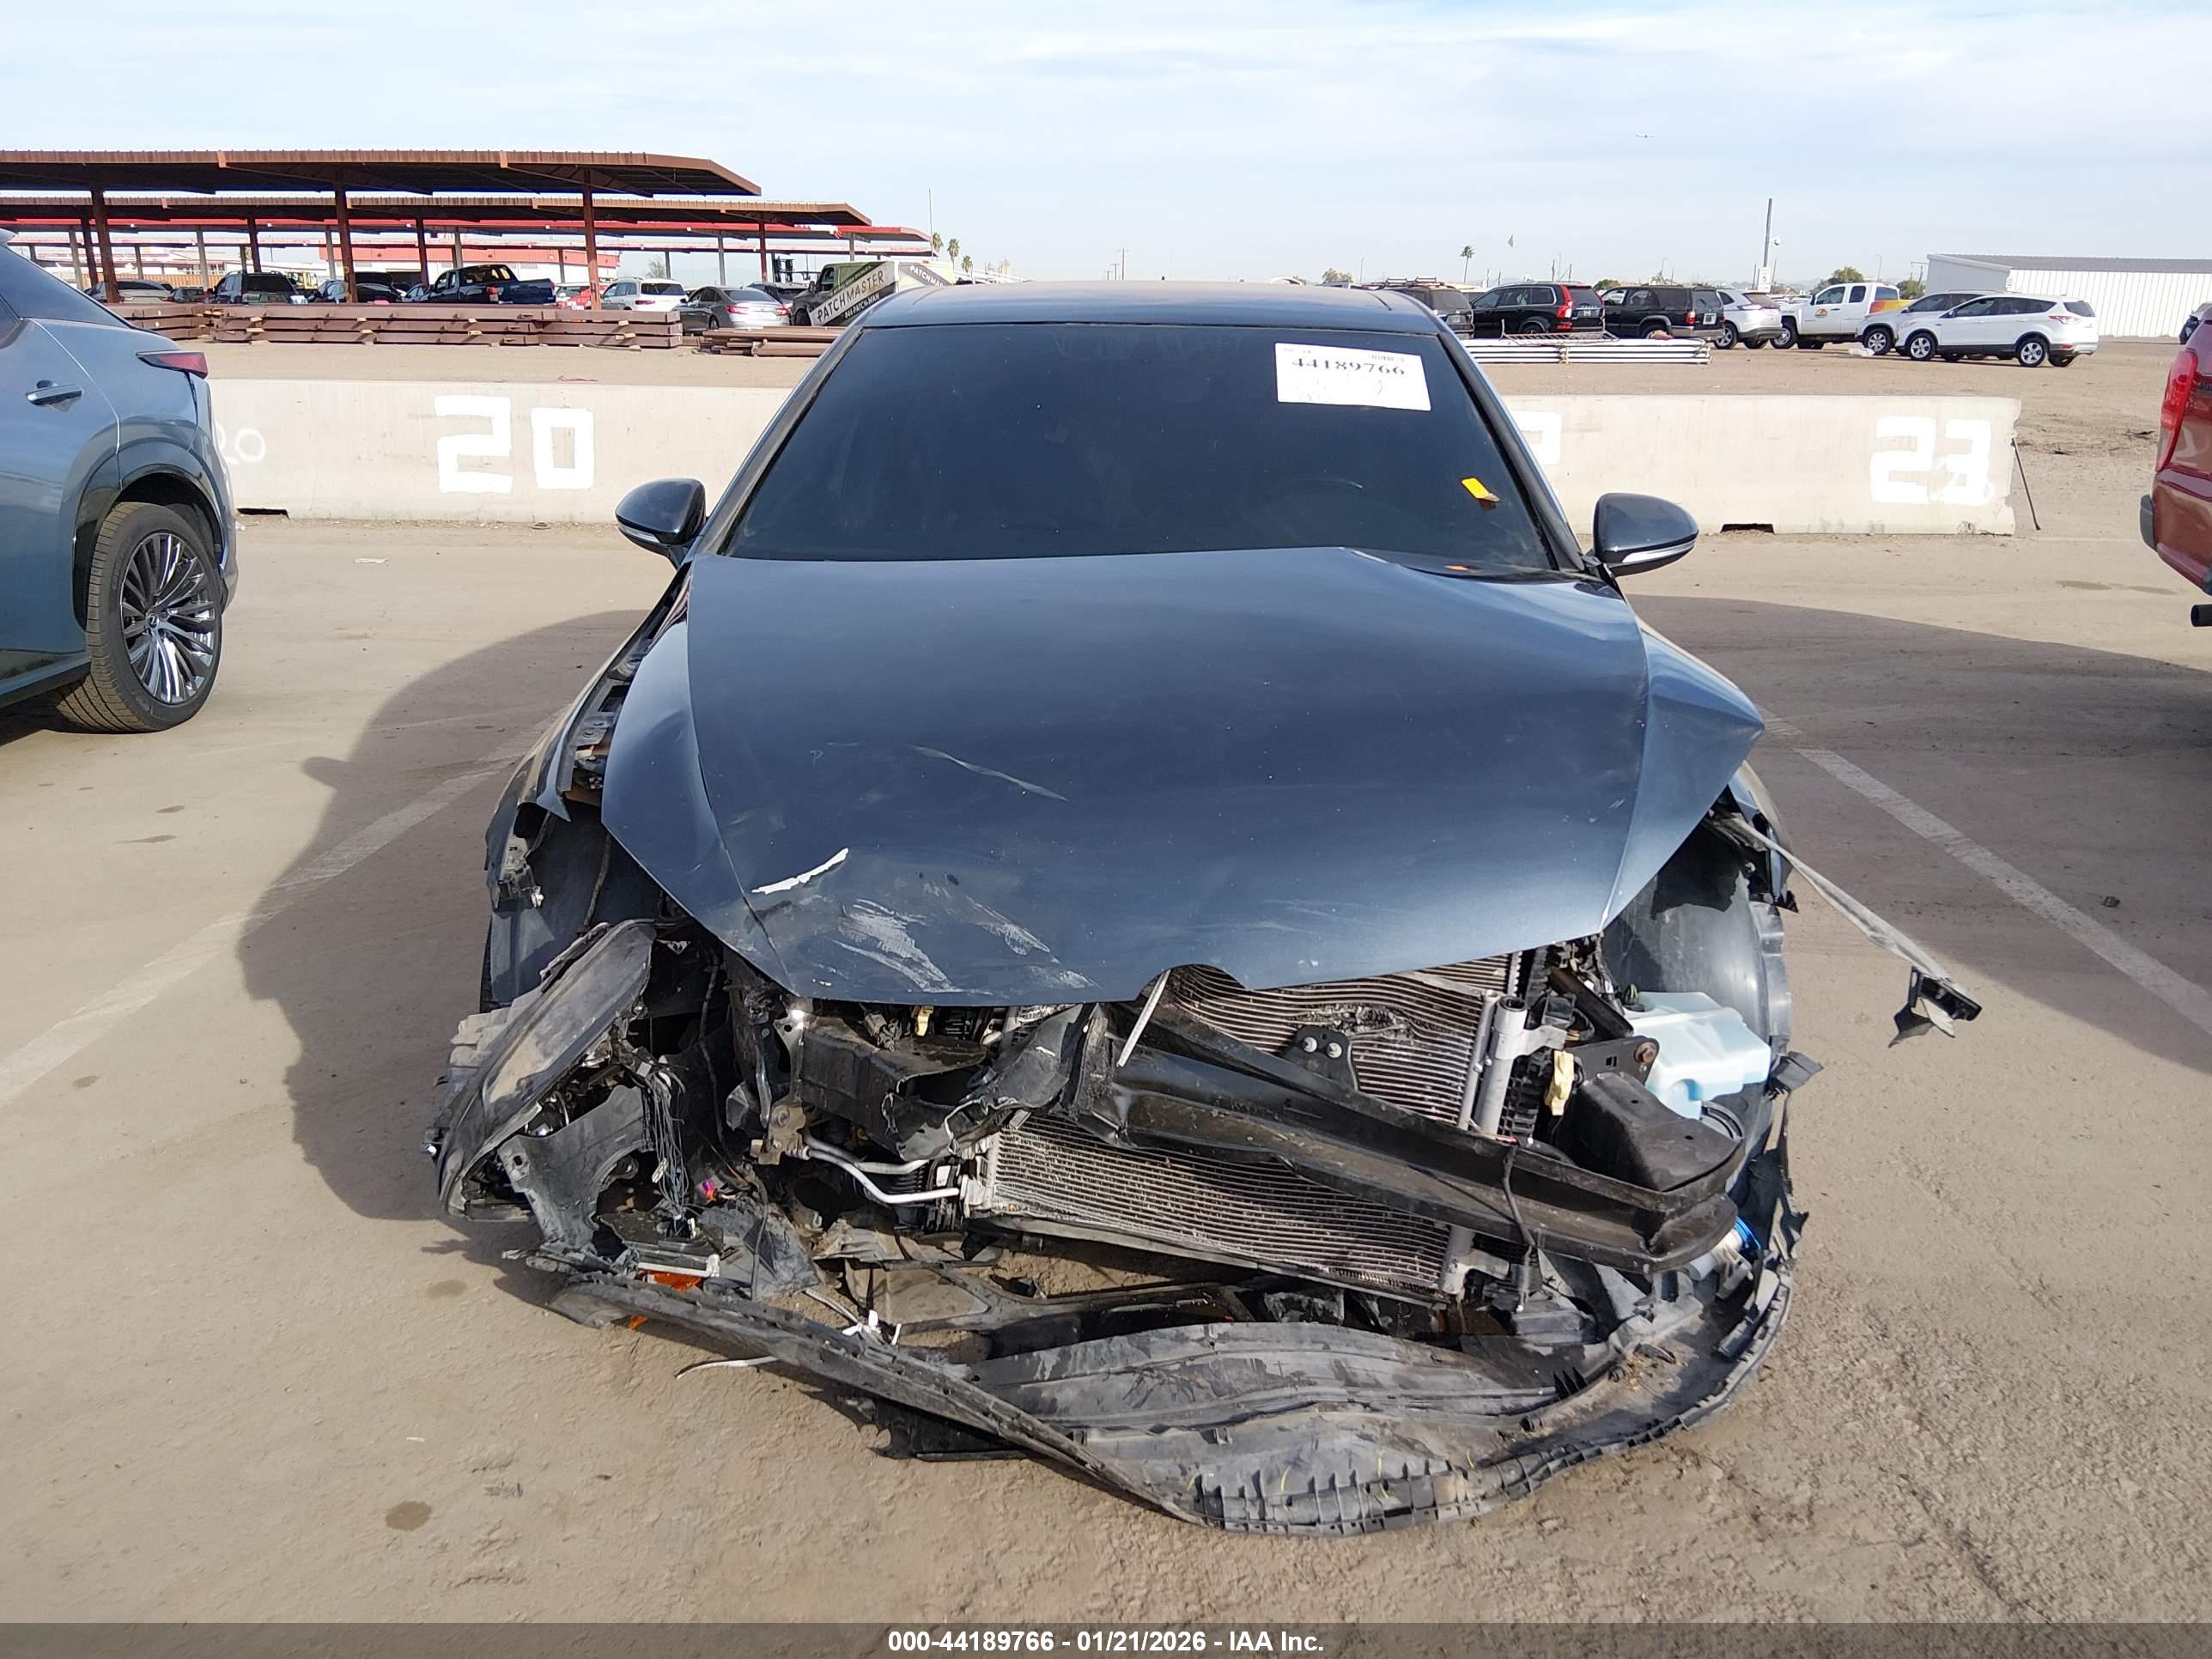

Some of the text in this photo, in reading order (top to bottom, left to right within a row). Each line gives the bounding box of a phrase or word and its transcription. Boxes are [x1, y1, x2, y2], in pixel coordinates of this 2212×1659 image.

[817, 270, 884, 321] PATCHMASTER
[1291, 358, 1405, 375] 44189766
[434, 394, 594, 495] 20
[1870, 416, 1992, 506] 23
